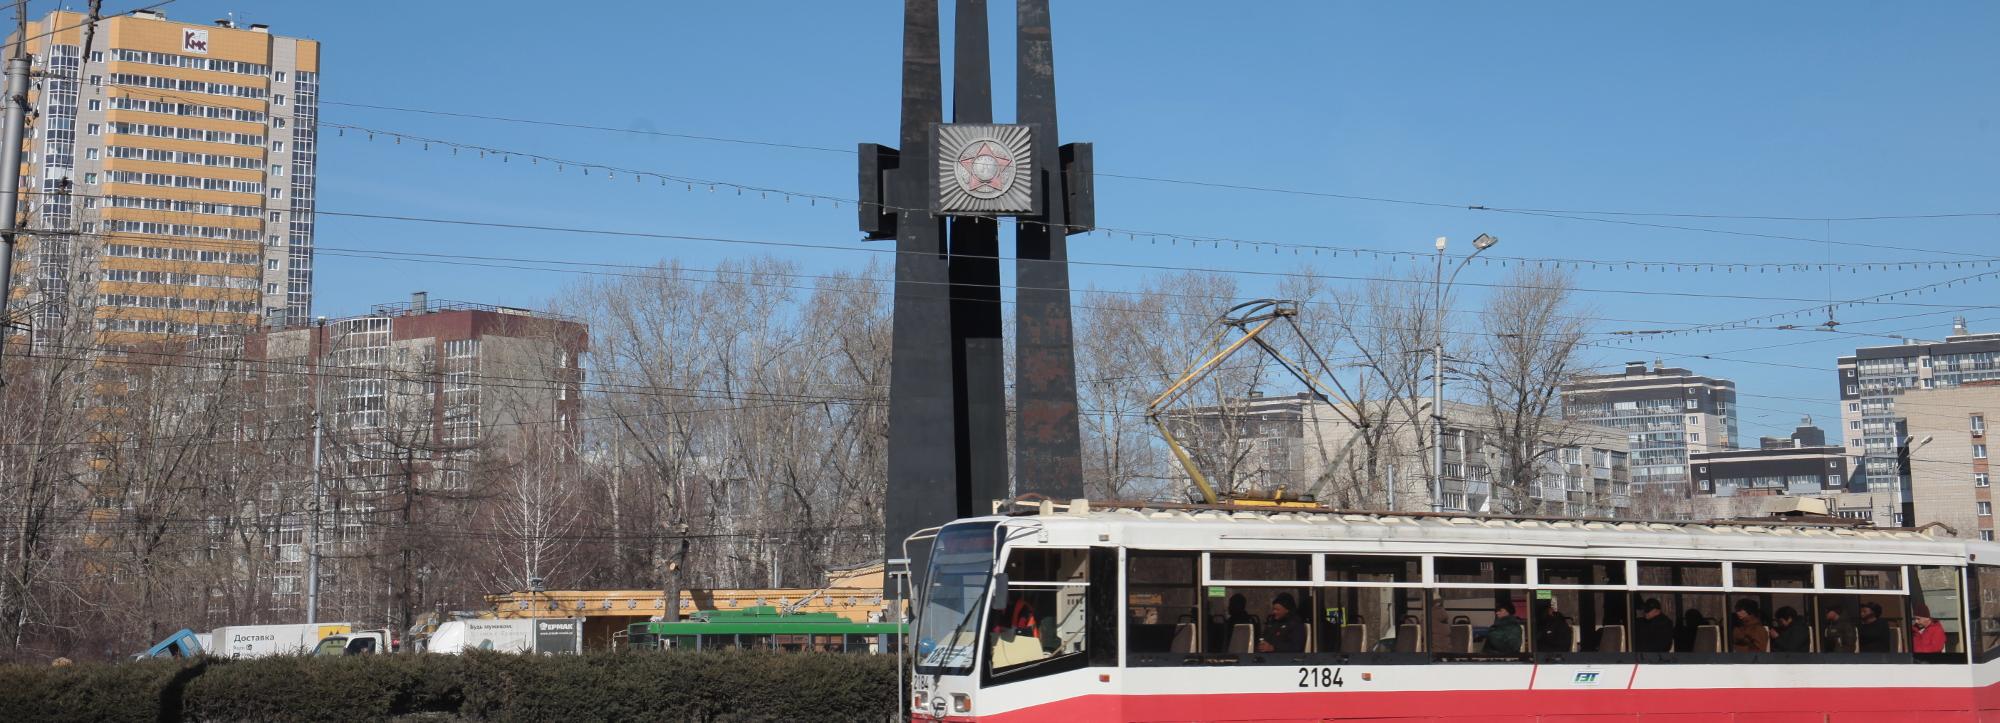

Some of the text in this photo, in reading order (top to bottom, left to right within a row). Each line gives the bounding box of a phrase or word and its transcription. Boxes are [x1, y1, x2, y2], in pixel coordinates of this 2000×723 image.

[233, 633, 275, 643] Доставка
[914, 674, 929, 690] 2184
[1298, 667, 1344, 688] 2184
